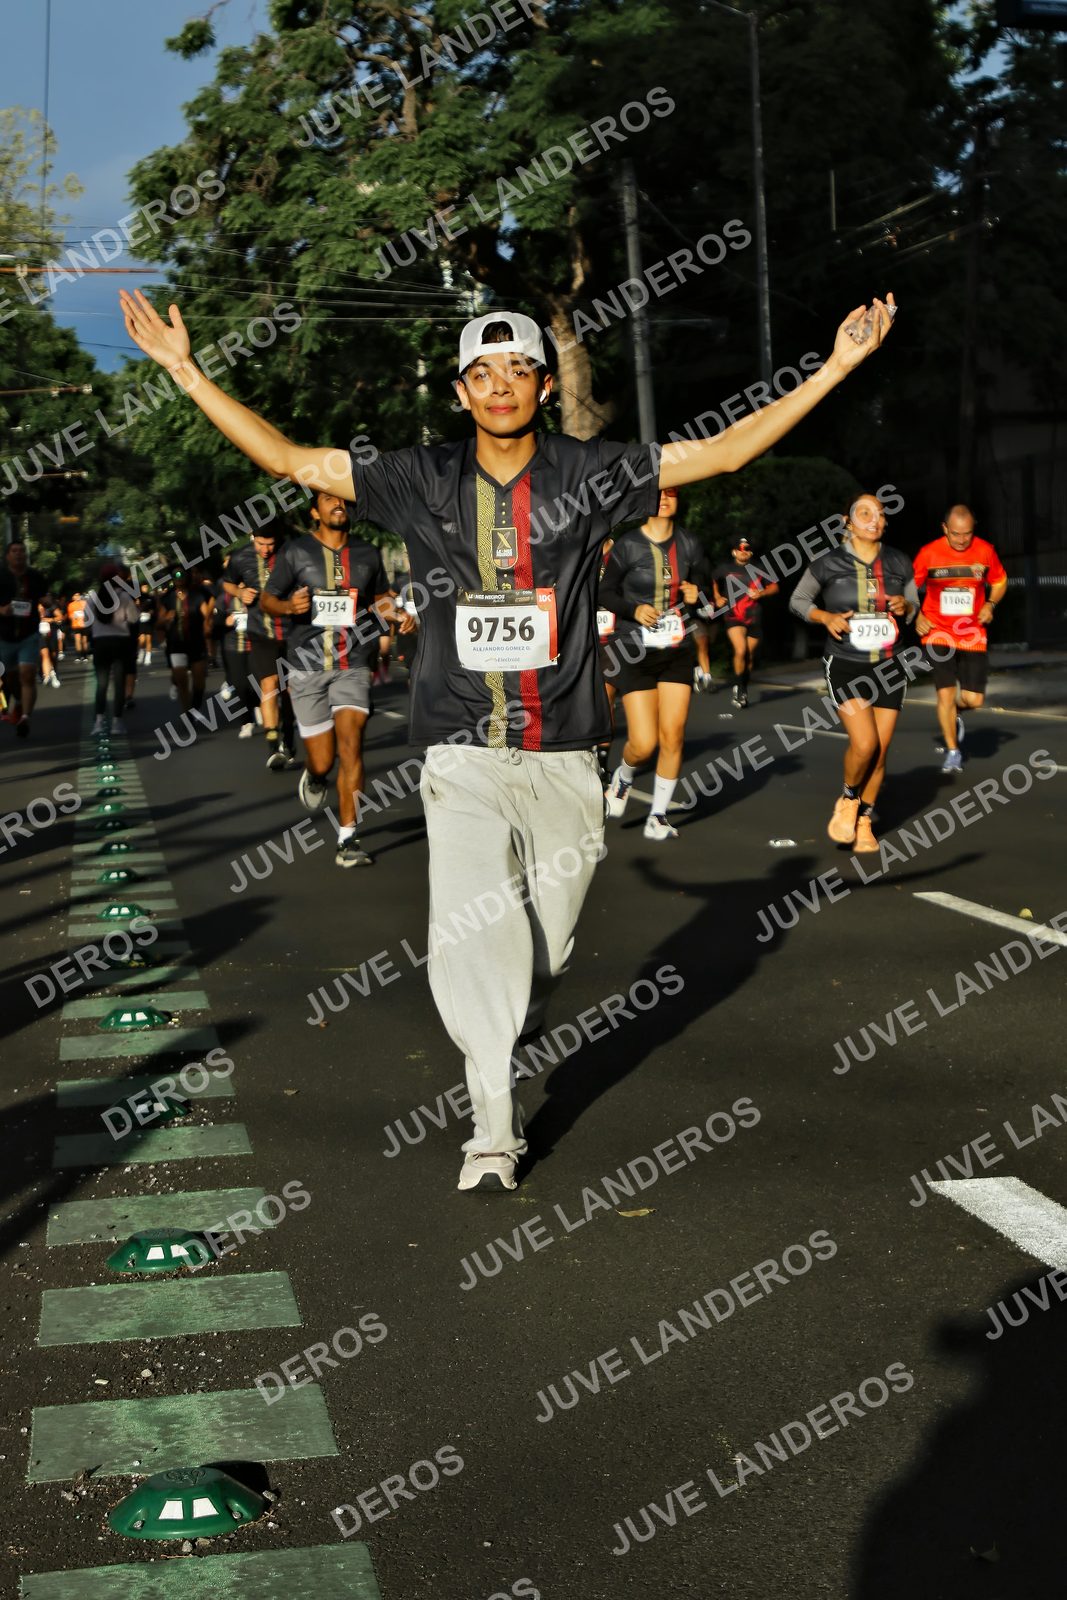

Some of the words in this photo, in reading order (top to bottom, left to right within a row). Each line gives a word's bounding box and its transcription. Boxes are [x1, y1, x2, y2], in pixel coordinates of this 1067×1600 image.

[943, 596, 971, 604] 11062
[318, 601, 347, 612] 9154
[468, 616, 535, 642] 9756
[858, 624, 888, 636] 9790
